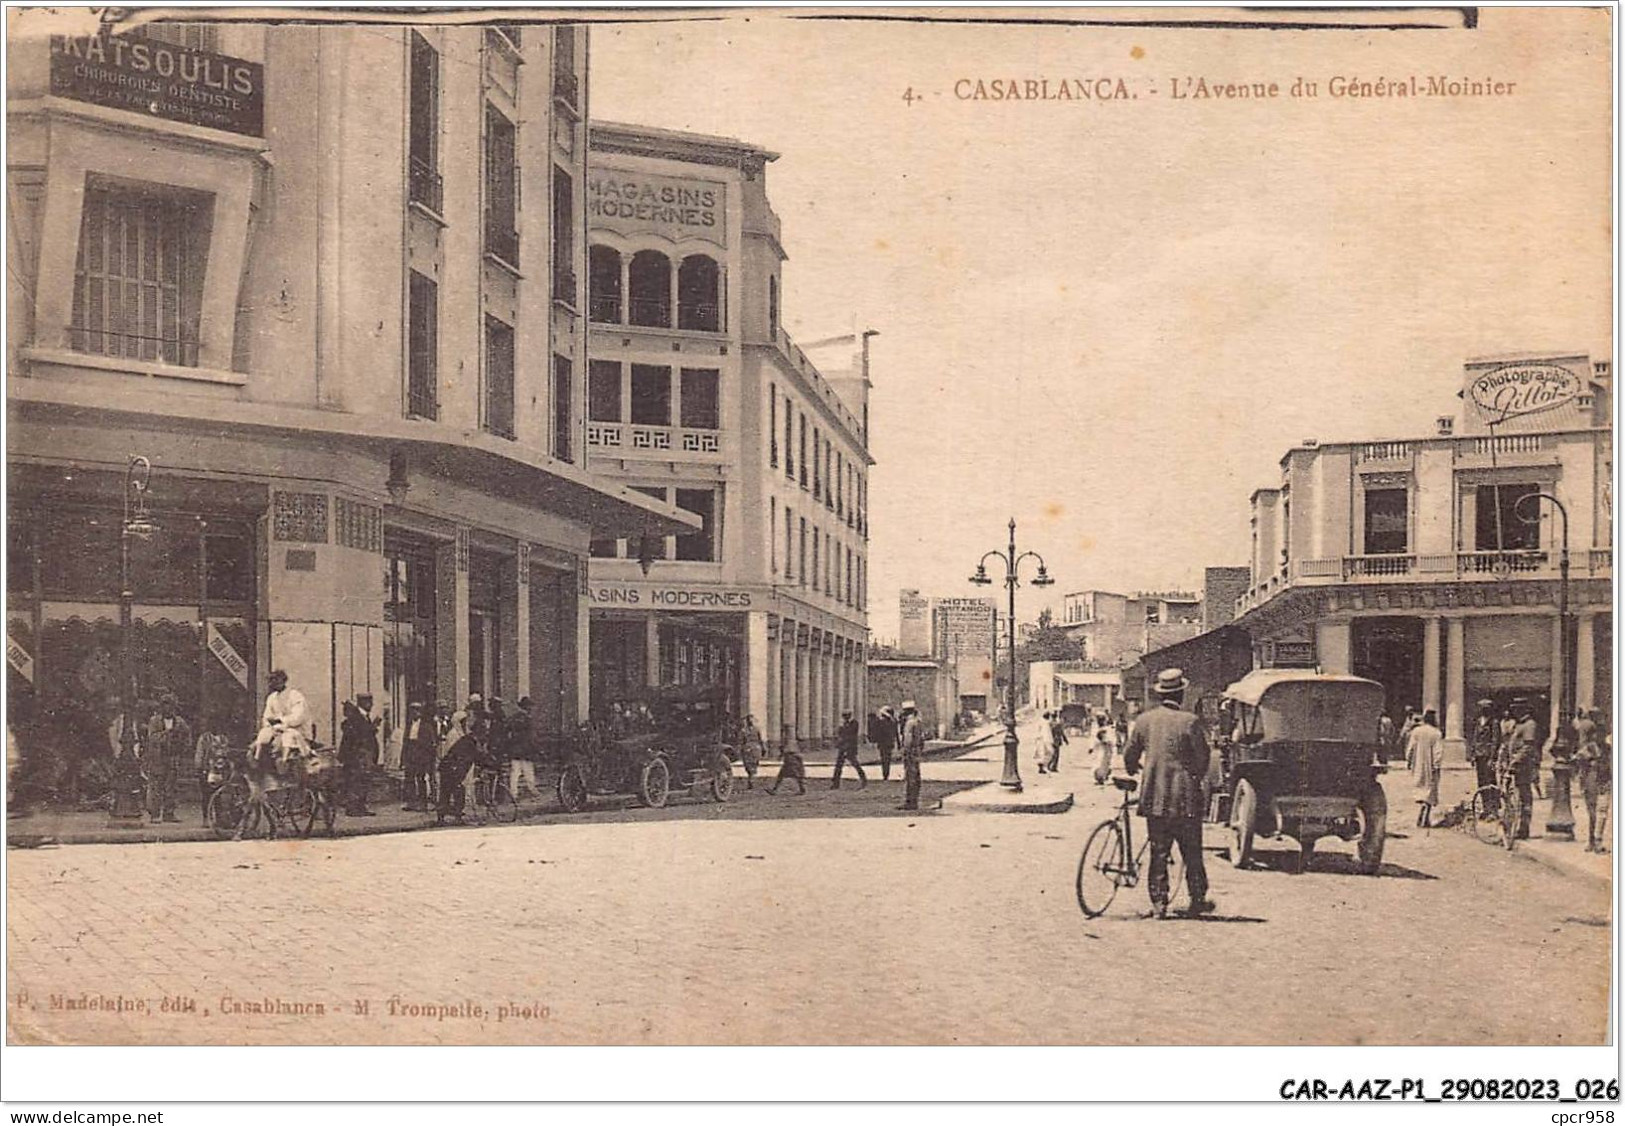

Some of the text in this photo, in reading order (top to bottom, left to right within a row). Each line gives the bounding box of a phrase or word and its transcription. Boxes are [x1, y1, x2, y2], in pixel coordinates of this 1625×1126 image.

[168, 84, 241, 110] DENTISTE
[588, 179, 716, 208] MAGASINS
[588, 199, 716, 227] MODERNES
[651, 590, 752, 607] MODERNES
[942, 598, 986, 606] HOTEL
